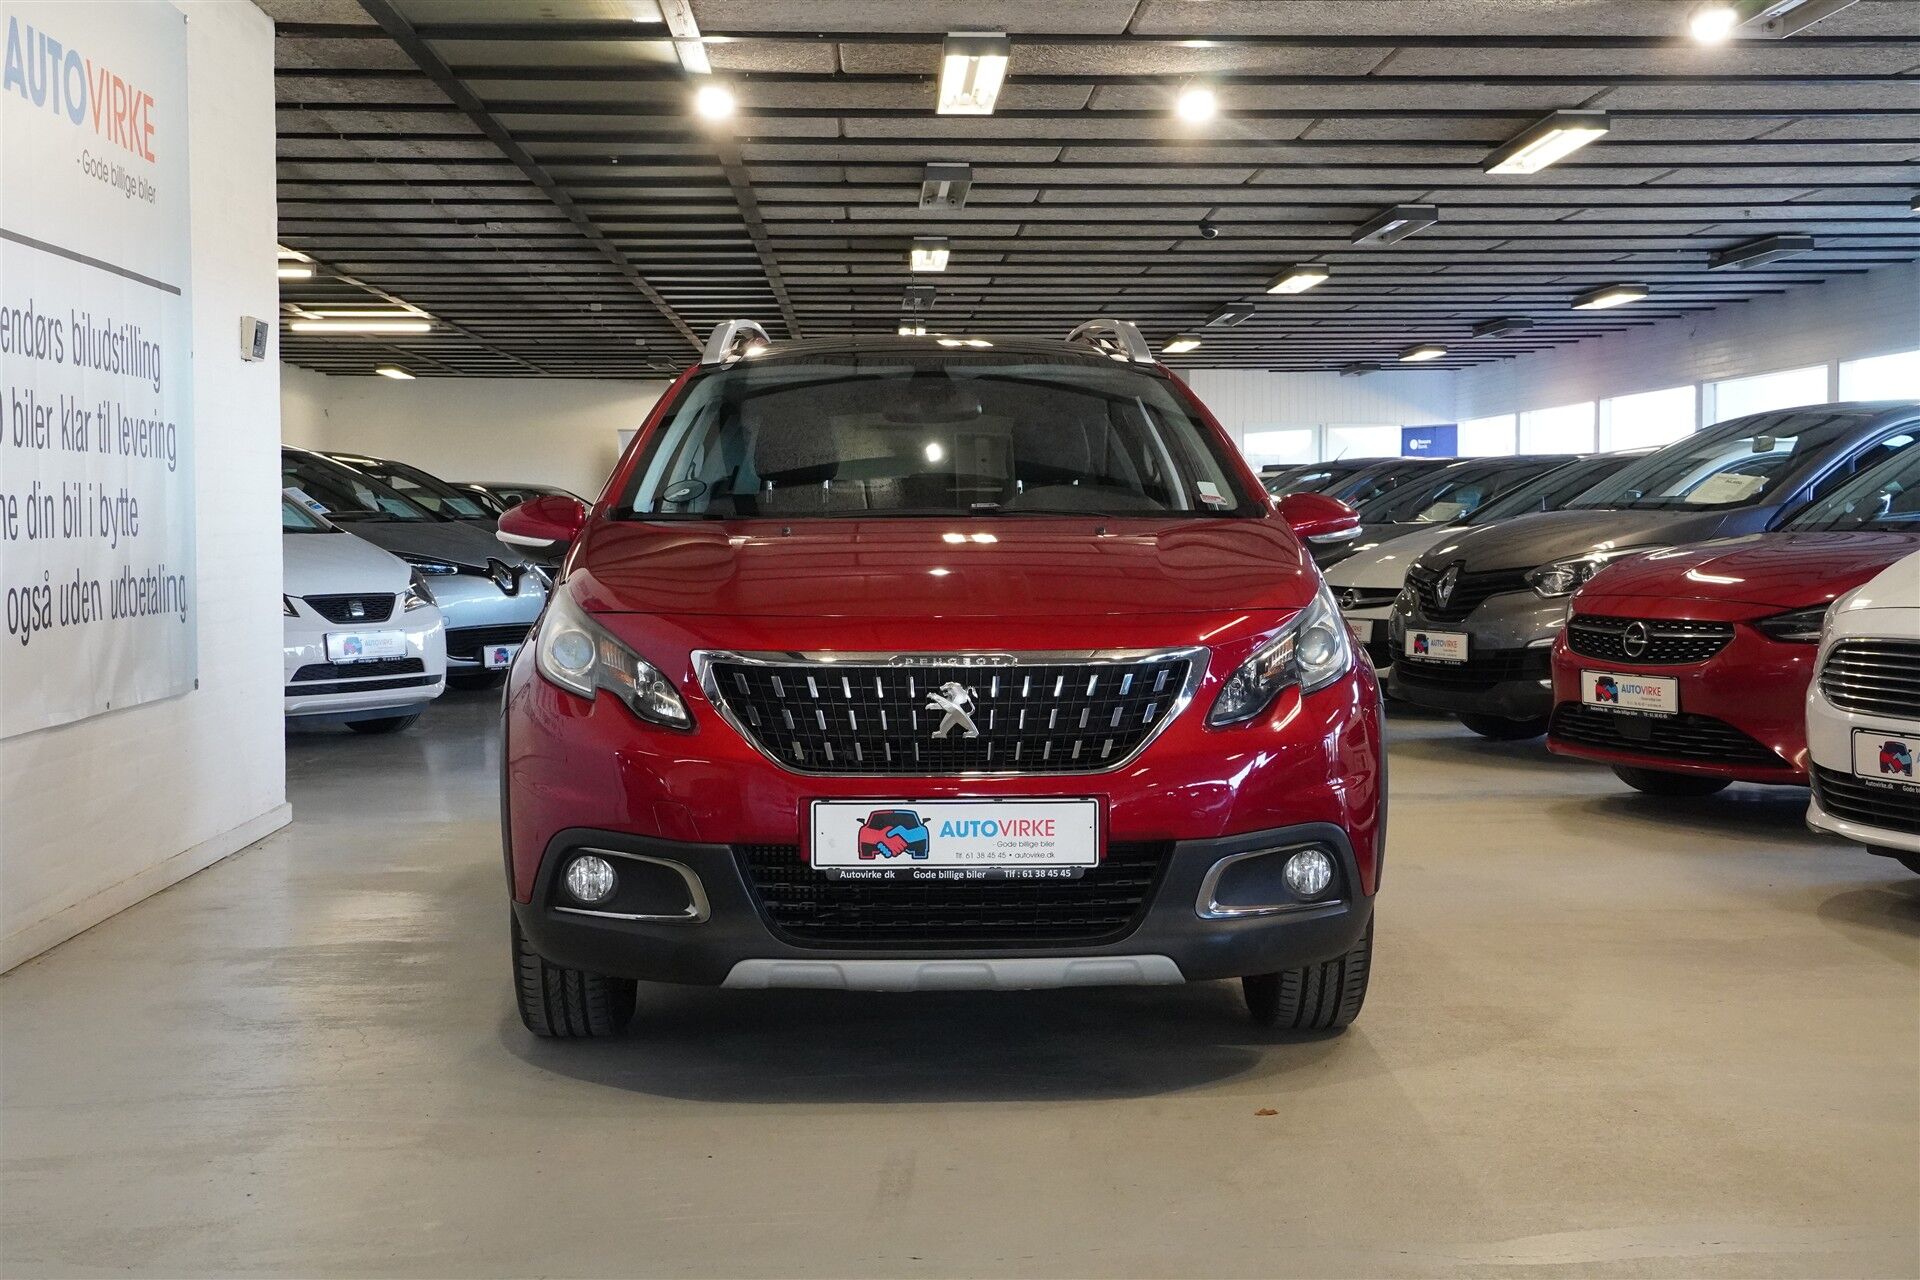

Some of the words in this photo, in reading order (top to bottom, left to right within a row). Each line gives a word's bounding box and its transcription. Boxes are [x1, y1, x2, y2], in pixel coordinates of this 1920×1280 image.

[3, 15, 156, 163] AUTOVIRKE
[82, 149, 109, 183] Gode
[111, 161, 137, 199] billige
[138, 175, 156, 204] biler
[0, 298, 64, 364] endørs
[71, 308, 161, 394] biludstilling
[12, 386, 53, 450] biler
[60, 394, 91, 452] klar
[97, 400, 111, 454] til
[117, 402, 177, 472] levering
[26, 480, 55, 540] din
[63, 481, 82, 538] bil
[89, 482, 93, 537] i
[99, 482, 139, 549] bytte
[7, 570, 53, 646] også
[60, 568, 103, 627] uden
[1621, 684, 1662, 697] AUTOVIRKE
[939, 819, 1055, 838] AUTOVIRKE
[996, 840, 1017, 848] Gode
[1018, 839, 1039, 849] billige
[1040, 840, 1056, 848] biler
[839, 870, 882, 879] Autovirke
[913, 870, 937, 879] Gode
[938, 870, 964, 880] billige
[966, 870, 987, 879] biler
[1022, 869, 1033, 878] 61
[1035, 869, 1046, 878] 38
[1047, 869, 1059, 878] 45
[1060, 869, 1072, 878] 45
